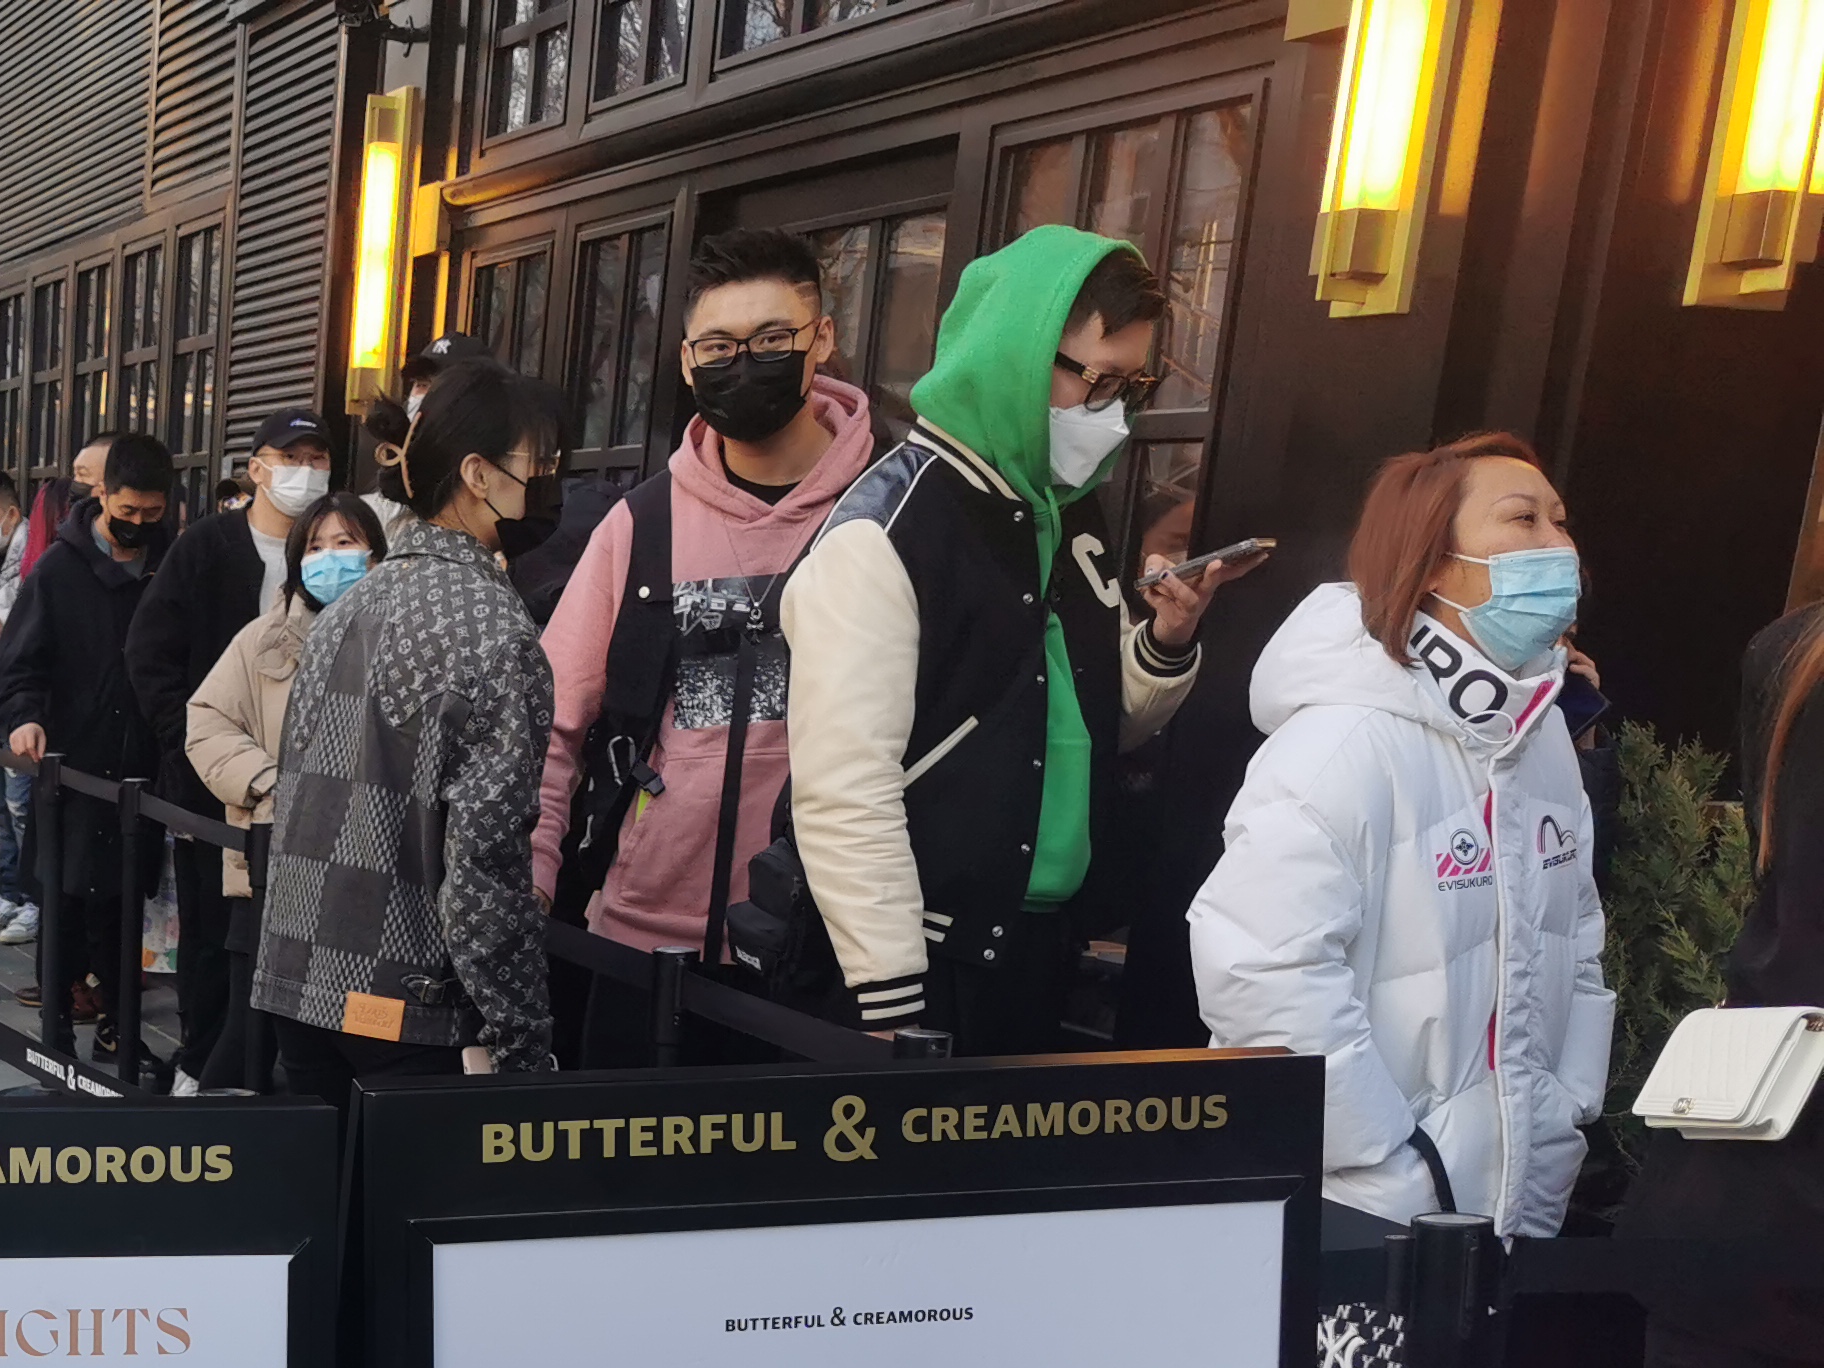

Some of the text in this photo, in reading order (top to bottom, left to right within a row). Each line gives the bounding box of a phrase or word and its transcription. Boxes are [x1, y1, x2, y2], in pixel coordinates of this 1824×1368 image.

[1438, 876, 1493, 891] EVISUKURO
[27, 1049, 65, 1081] BUTTERFUL
[68, 1064, 76, 1091] &
[483, 1095, 1227, 1163] BUTTERFUL & CREAMOROUS
[726, 1307, 973, 1332] BUTTERFUL & CREAMOROUS
